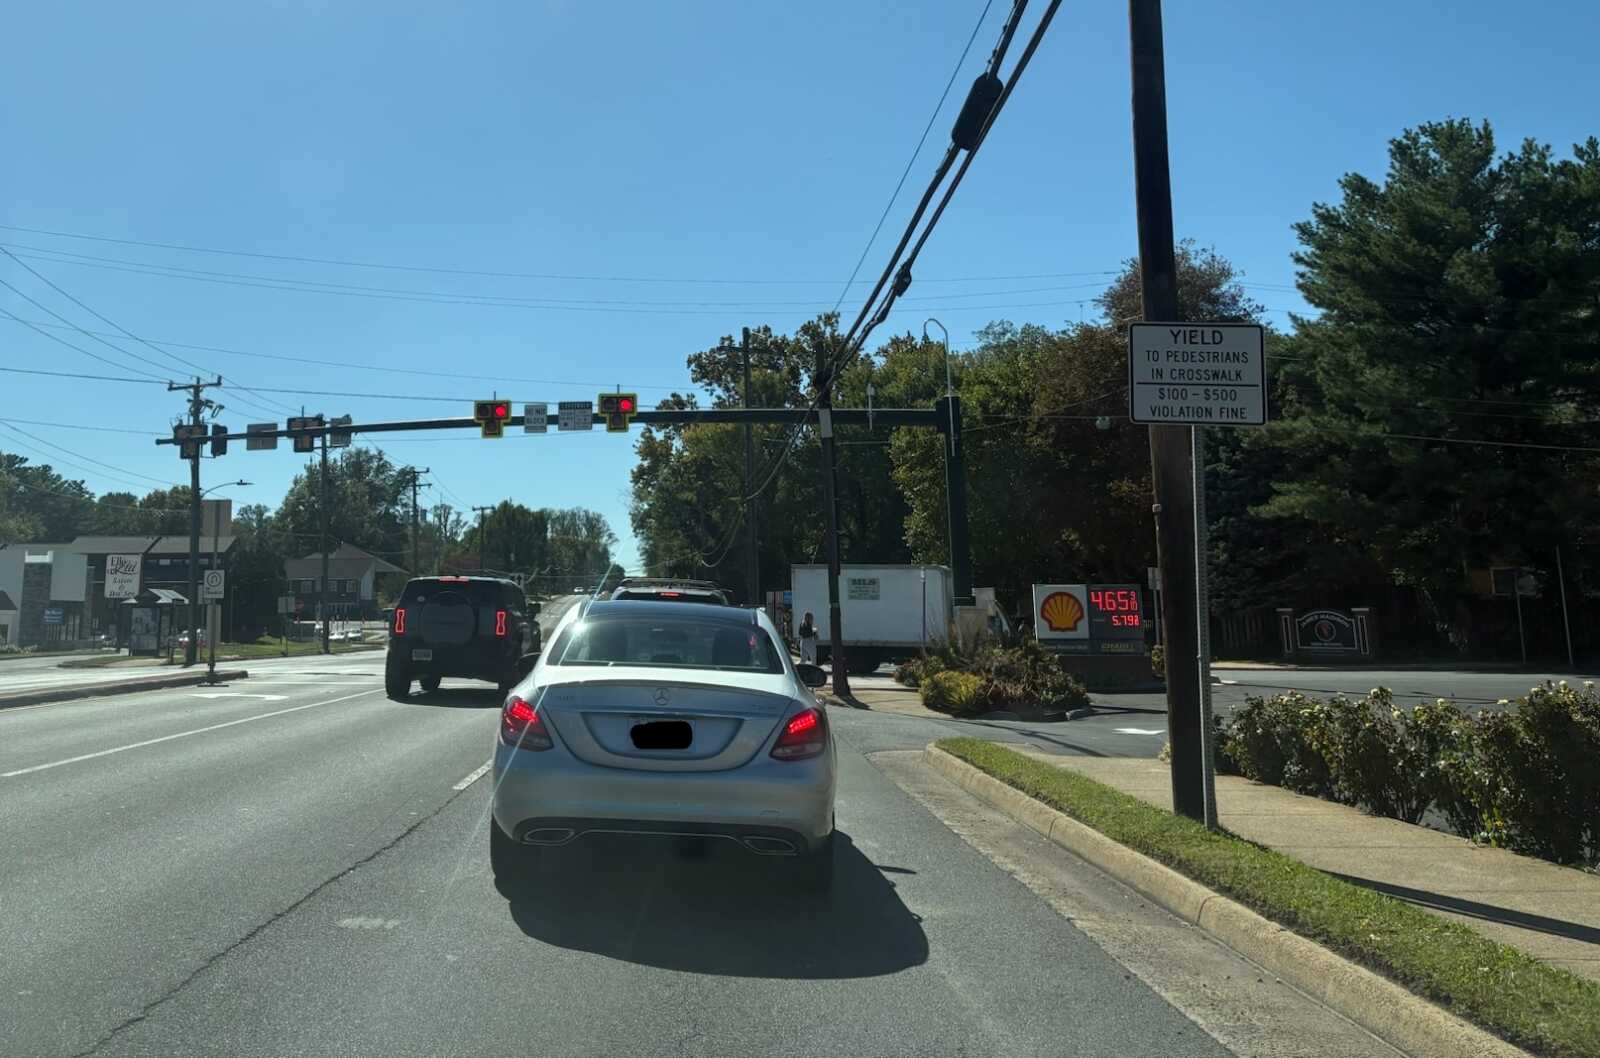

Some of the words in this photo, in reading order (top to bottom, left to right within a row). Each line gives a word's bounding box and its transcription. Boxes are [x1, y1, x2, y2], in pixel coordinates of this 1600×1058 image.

[1170, 330, 1223, 345] YIELD
[1145, 350, 1160, 362] TO
[1166, 350, 1249, 363] PEDESTRIANS
[1151, 368, 1163, 379] IN
[1170, 368, 1242, 381] CROSSWALK
[1158, 387, 1188, 400] $100
[1204, 389, 1238, 401] $500
[1150, 405, 1212, 418] VIOLATION
[1219, 407, 1248, 419] FINE
